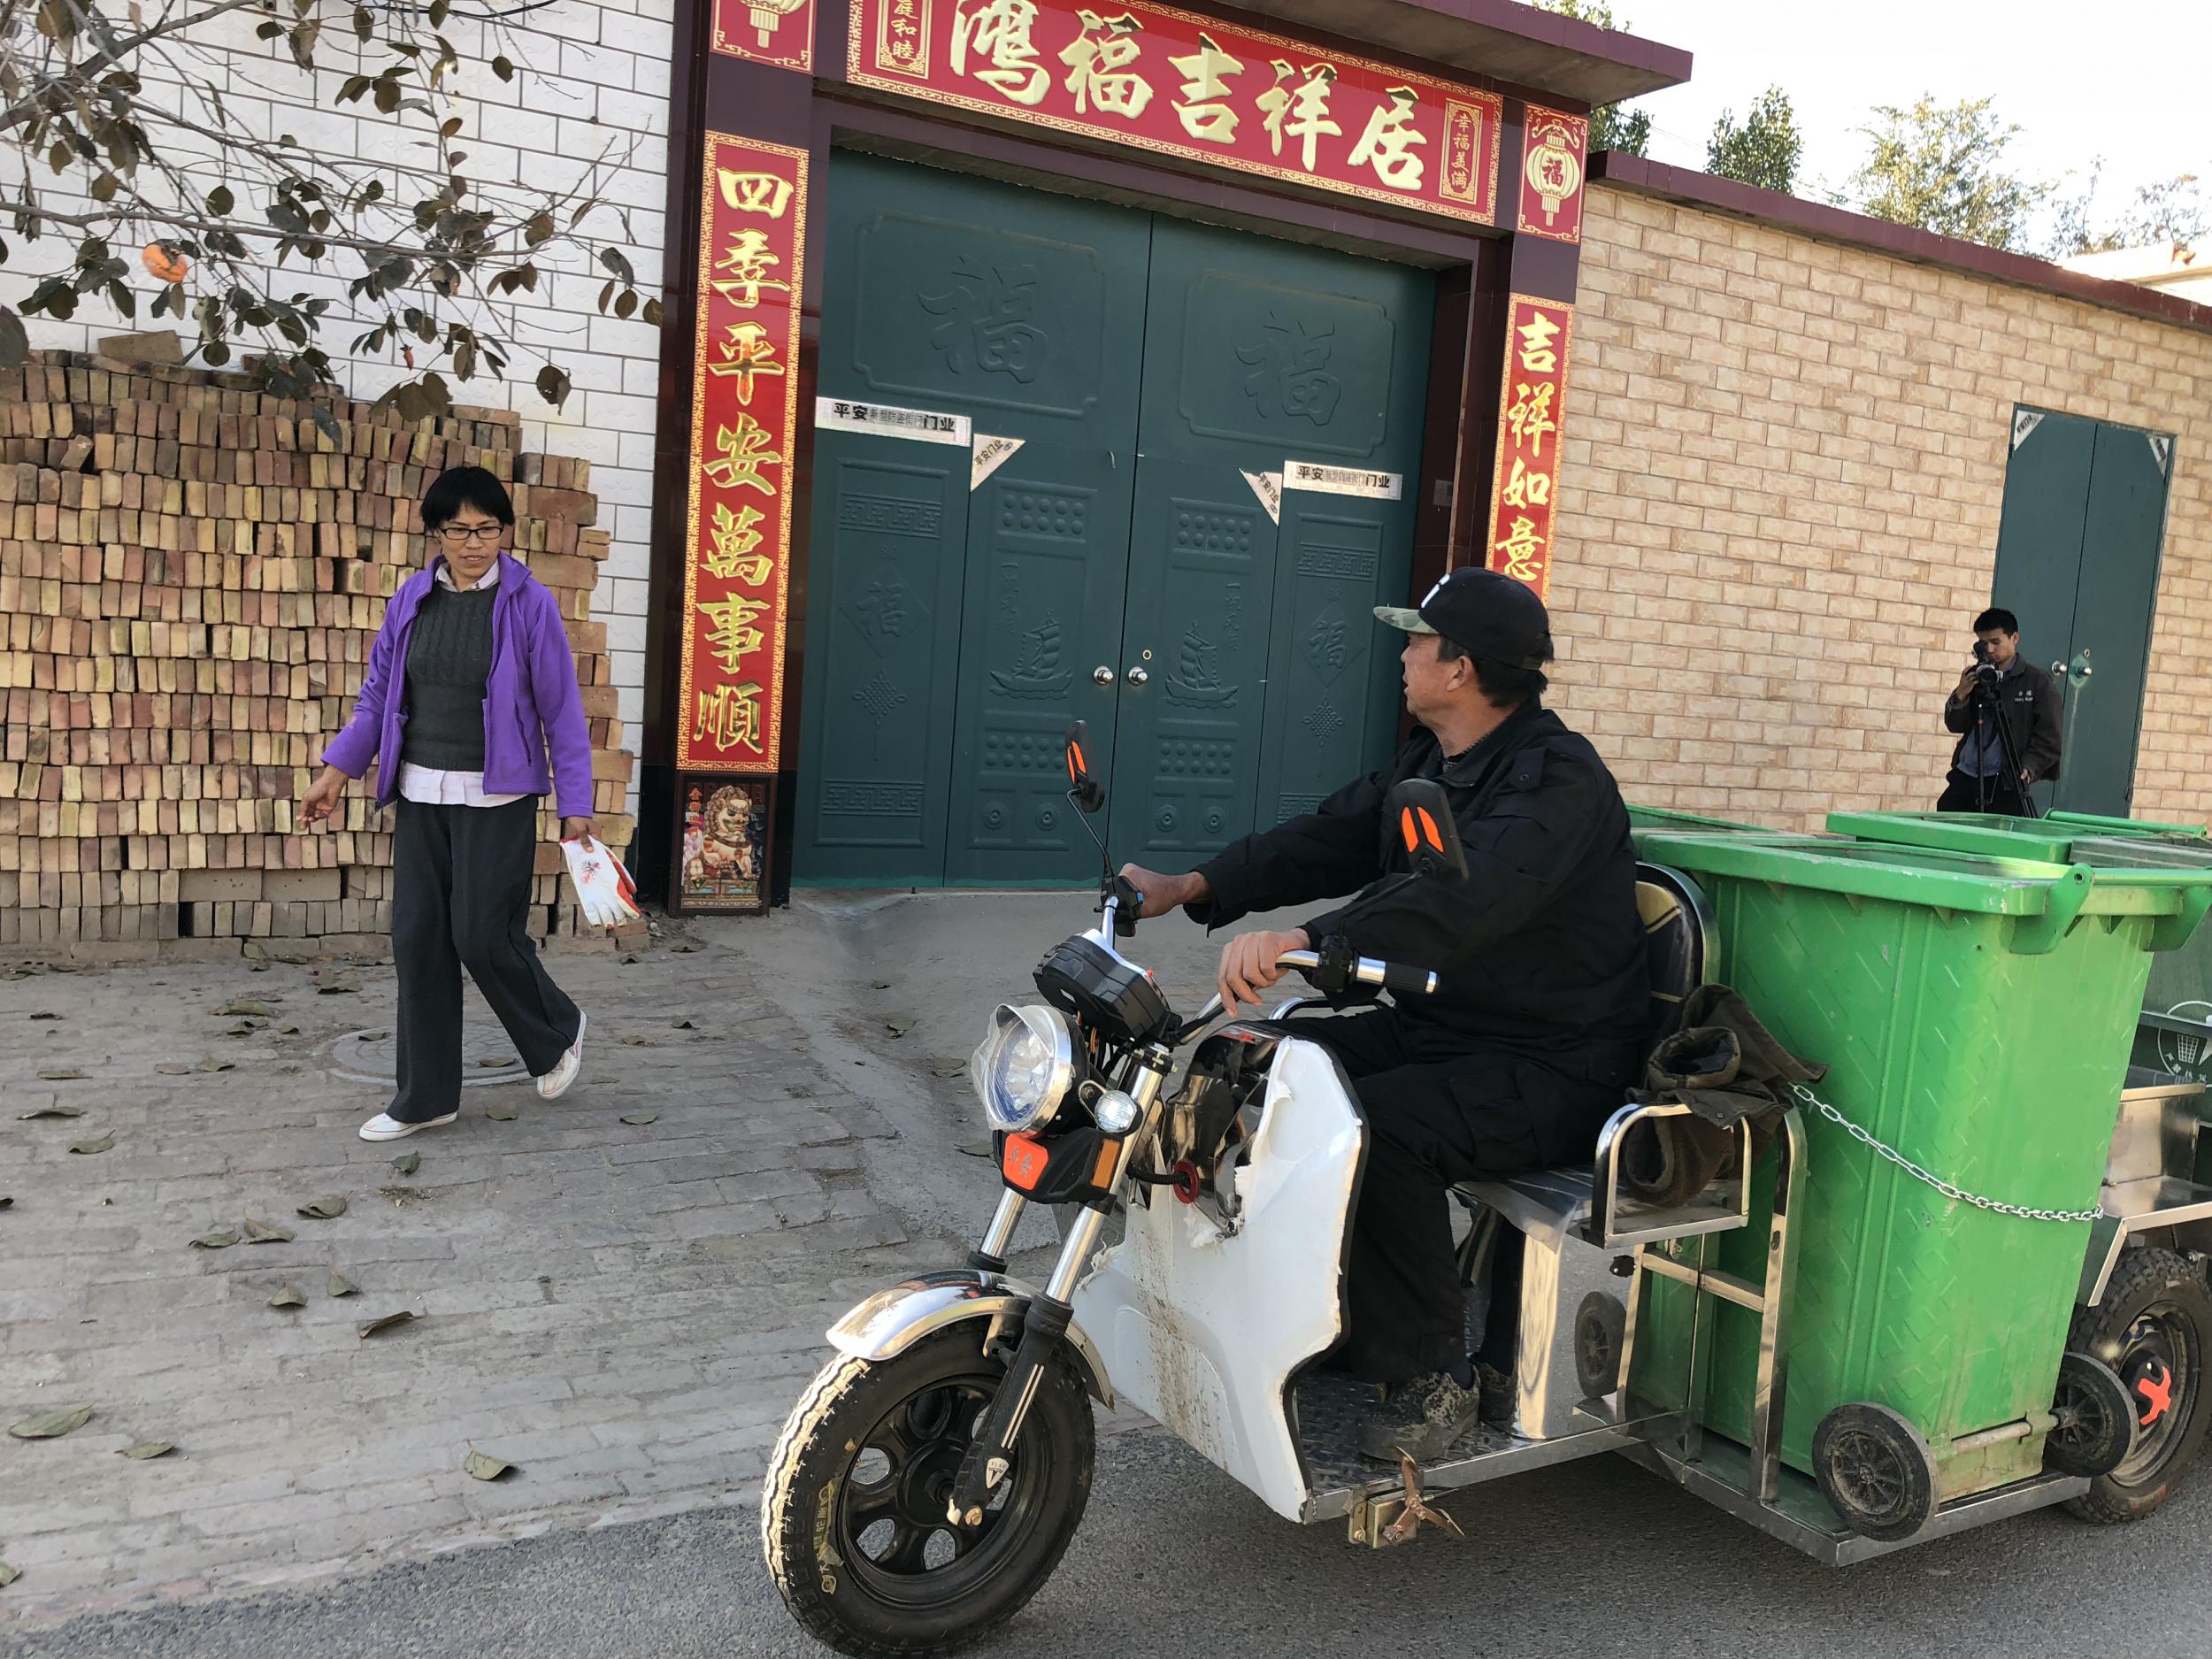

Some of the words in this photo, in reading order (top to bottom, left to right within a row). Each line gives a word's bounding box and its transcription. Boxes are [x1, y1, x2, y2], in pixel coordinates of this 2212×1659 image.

[949, 0, 1425, 190] 鸿福吉祥居
[1542, 157, 1564, 188] 福
[1495, 311, 1560, 581] 吉祥如意
